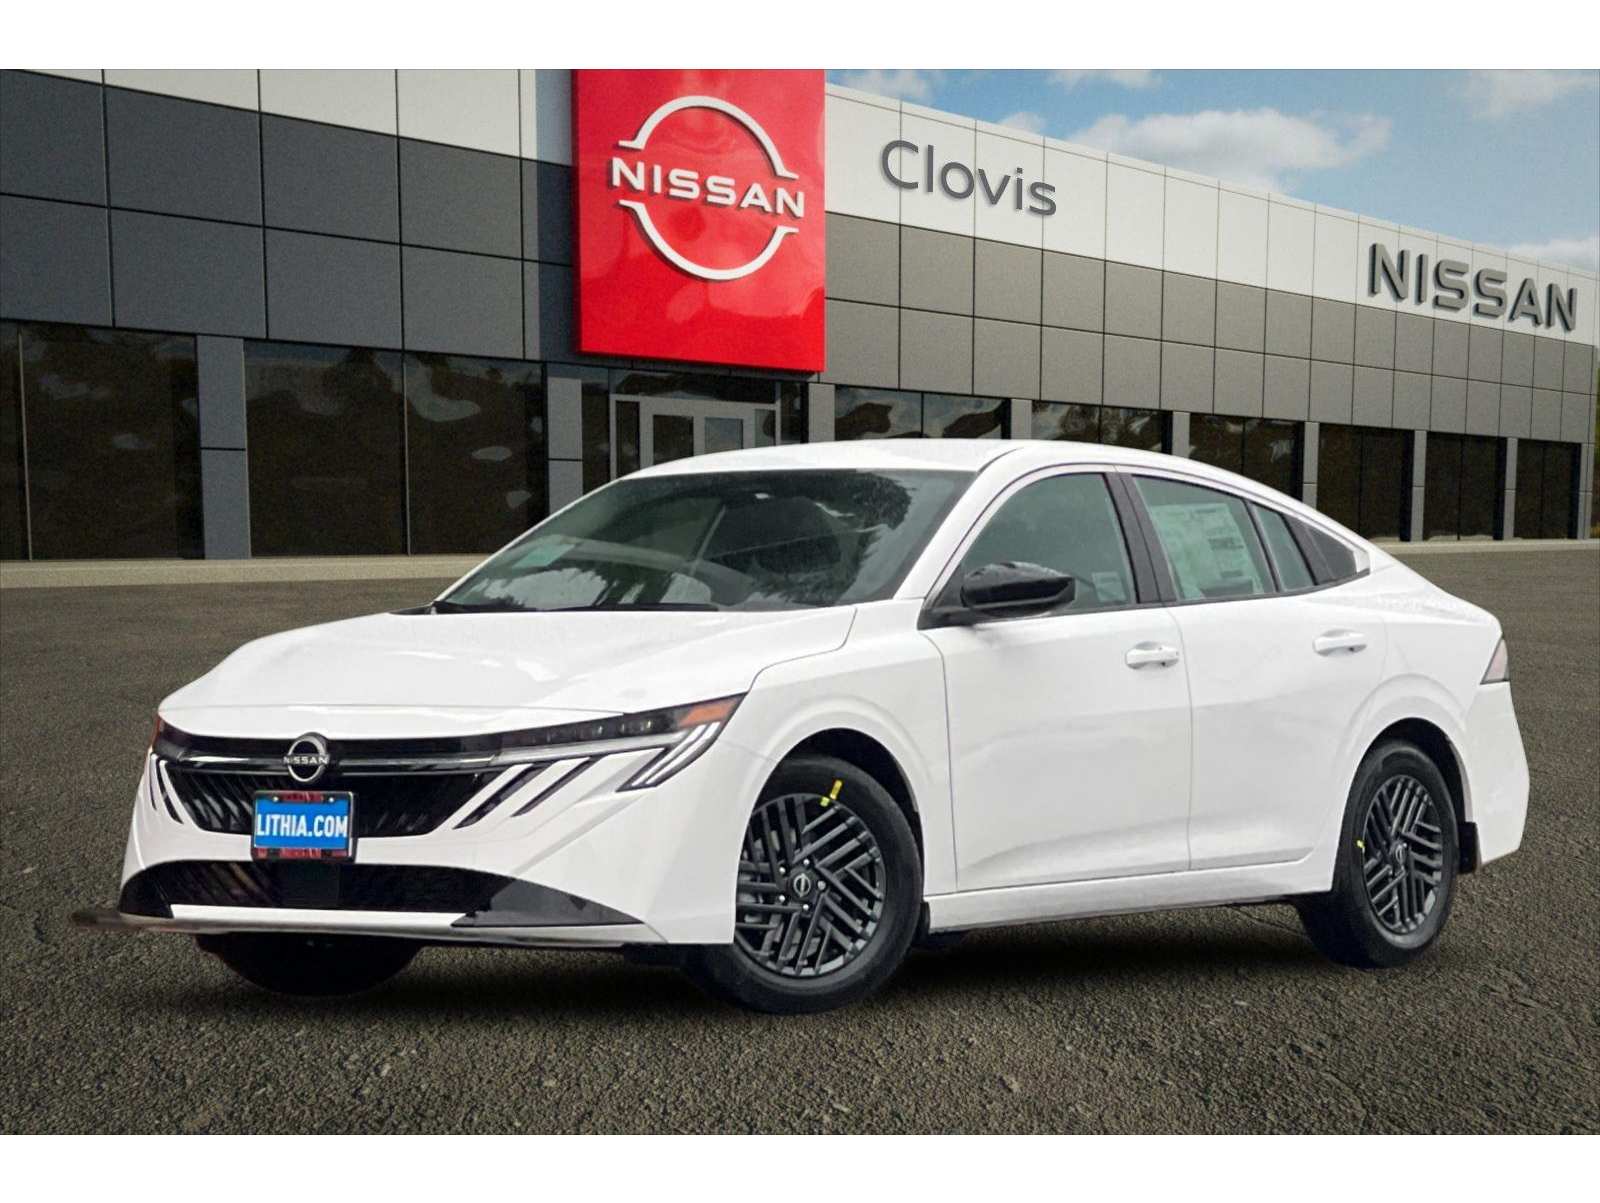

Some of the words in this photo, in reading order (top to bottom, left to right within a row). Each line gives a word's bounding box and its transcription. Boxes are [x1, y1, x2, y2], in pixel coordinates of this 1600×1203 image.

[610, 155, 805, 218] NISSAN
[880, 139, 1058, 216] Clovis
[1368, 242, 1578, 332] NISSAN
[283, 755, 329, 766] NISSAN
[256, 813, 348, 838] LITHIA.COM
